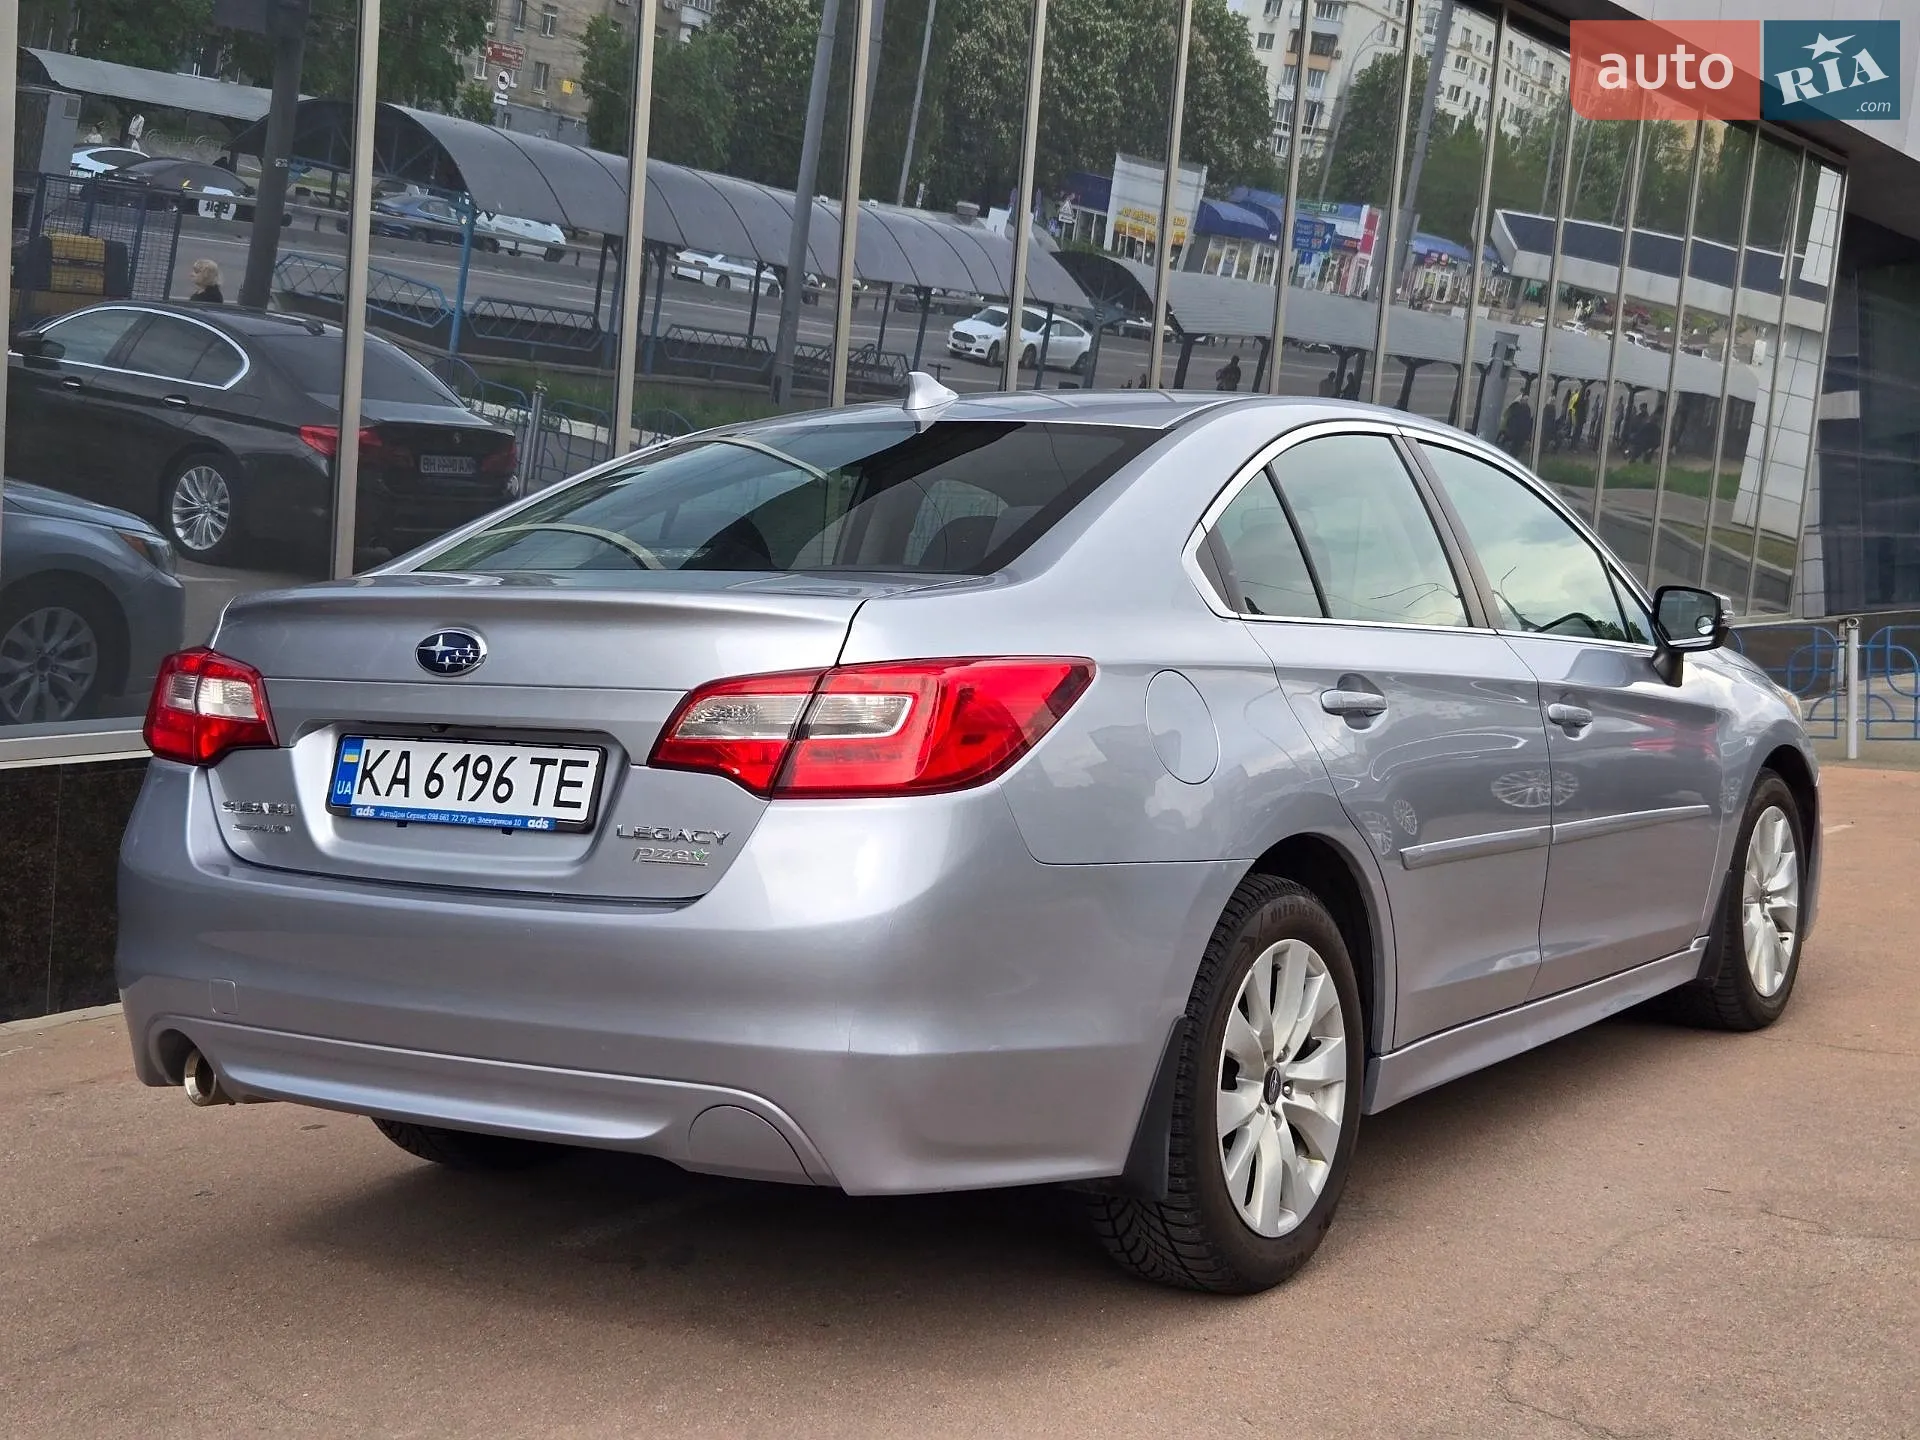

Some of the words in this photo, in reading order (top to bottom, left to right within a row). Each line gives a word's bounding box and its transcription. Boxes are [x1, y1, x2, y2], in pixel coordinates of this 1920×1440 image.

[356, 748, 411, 798] KA
[423, 752, 518, 804] 6196
[529, 757, 590, 809] TE
[336, 780, 352, 795] UA
[355, 806, 375, 817] ads
[527, 818, 549, 829] ads
[616, 823, 732, 846] LEGACY
